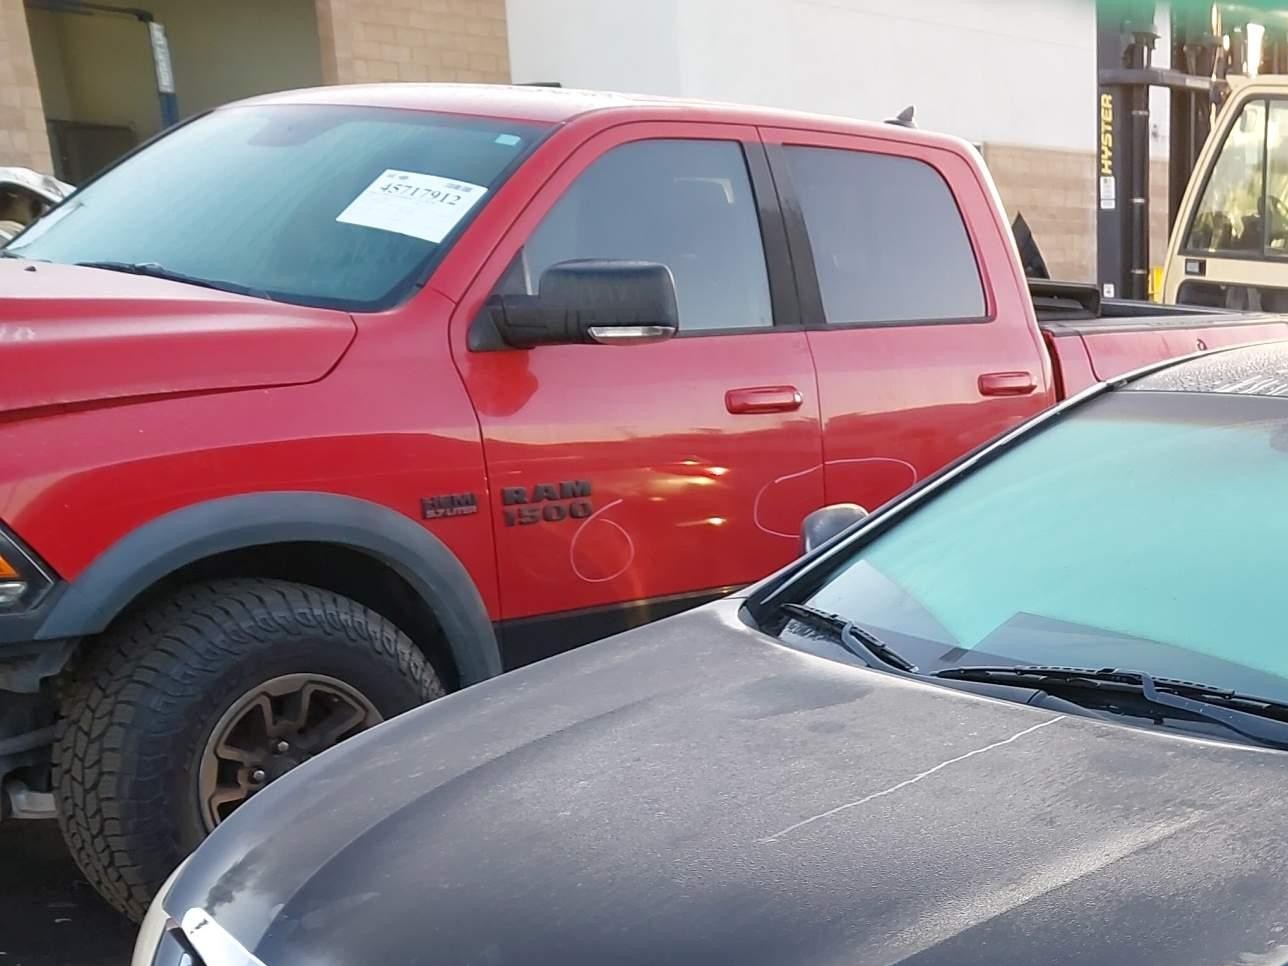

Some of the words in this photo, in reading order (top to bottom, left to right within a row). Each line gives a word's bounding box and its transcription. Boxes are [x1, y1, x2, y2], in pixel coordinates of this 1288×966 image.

[1100, 93, 1114, 176] HYSTER
[380, 182, 462, 206] 45717912
[502, 480, 592, 505] RAM
[504, 502, 593, 527] 1500
